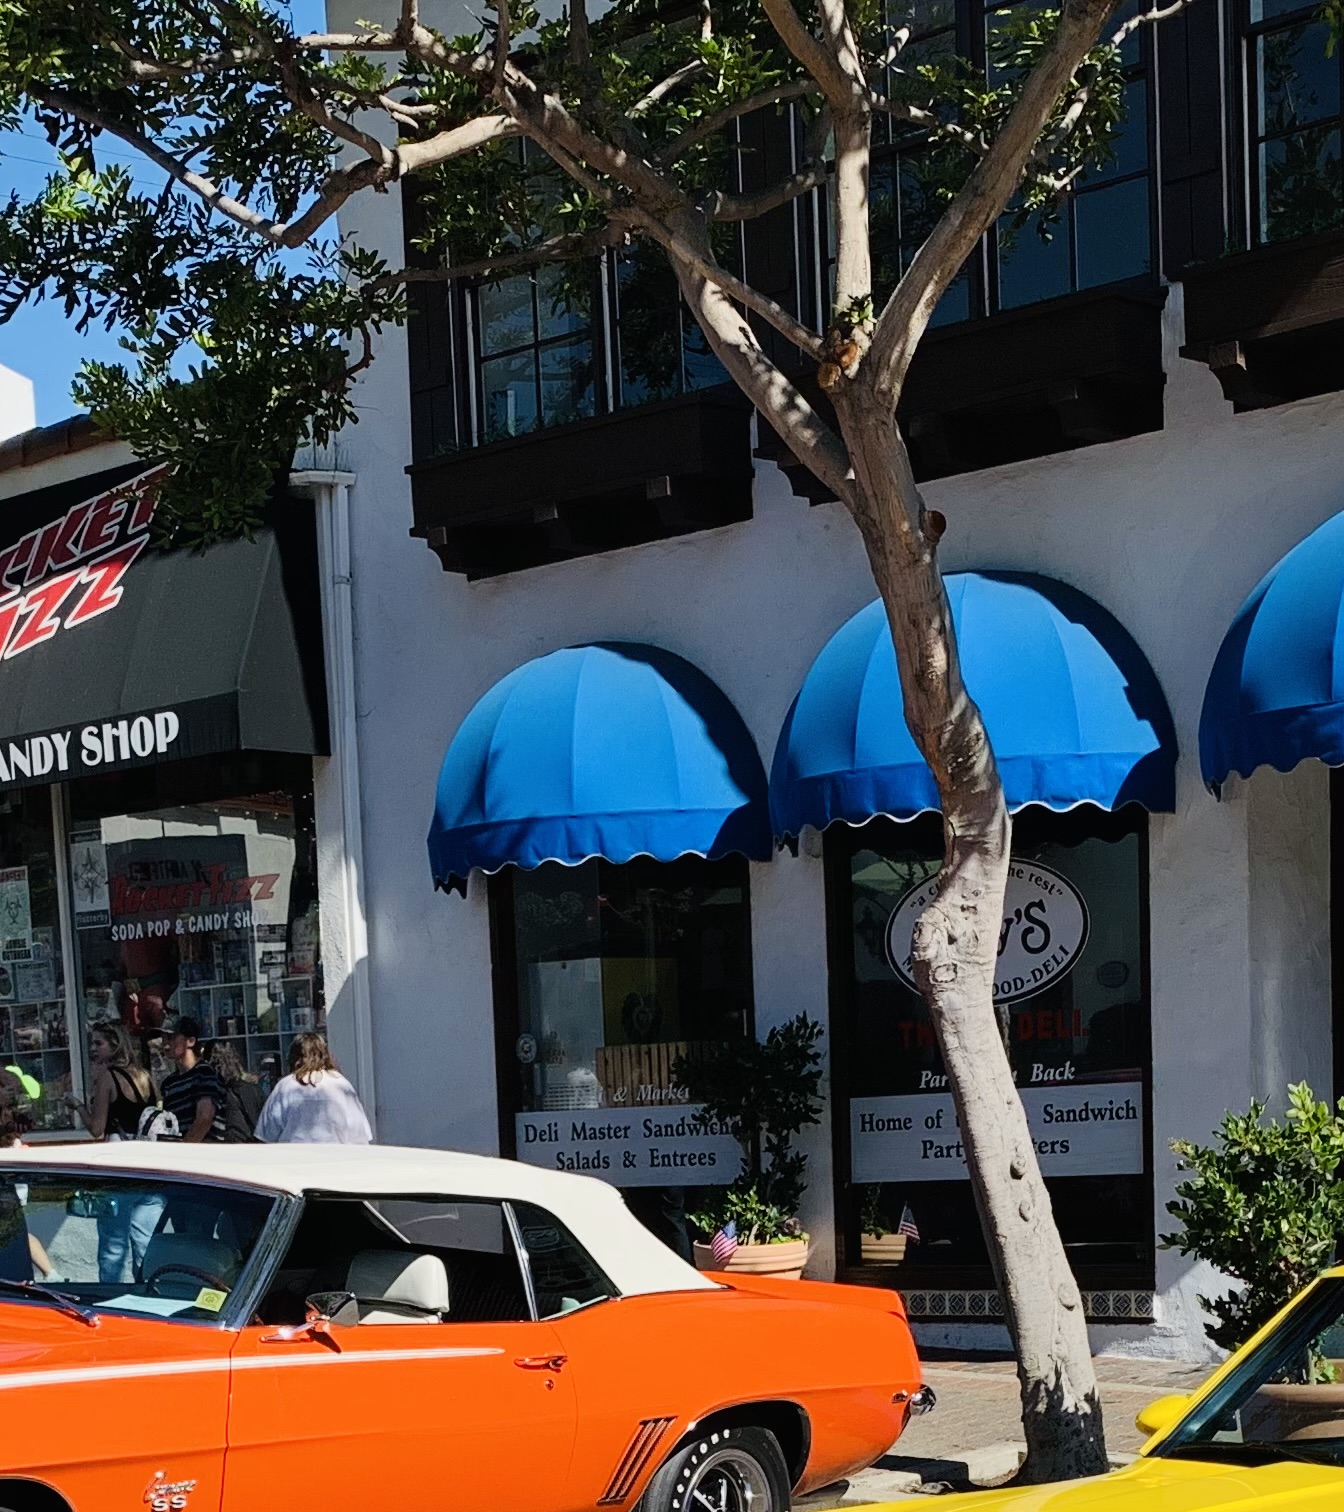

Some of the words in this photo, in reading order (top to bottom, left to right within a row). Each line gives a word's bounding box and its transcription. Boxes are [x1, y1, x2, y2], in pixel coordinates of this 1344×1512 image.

[80, 711, 180, 767] SHOP
[204, 864, 280, 906] FIZZ
[111, 922, 144, 942] SODA
[148, 918, 170, 938] POP
[175, 916, 185, 935] &
[188, 912, 230, 934] CANDY
[1030, 1061, 1076, 1083] Back
[613, 1086, 628, 1103] &
[860, 1113, 913, 1134] Home
[924, 1108, 944, 1130] of
[1042, 1100, 1139, 1124] Sandwich
[524, 1122, 559, 1144] Deli
[571, 1121, 631, 1142] Master
[1032, 1138, 1070, 1156] ters
[556, 1151, 611, 1171] Salads
[622, 1151, 637, 1168] &
[649, 1148, 717, 1168] Entrees
[151, 1494, 188, 1512] SS
